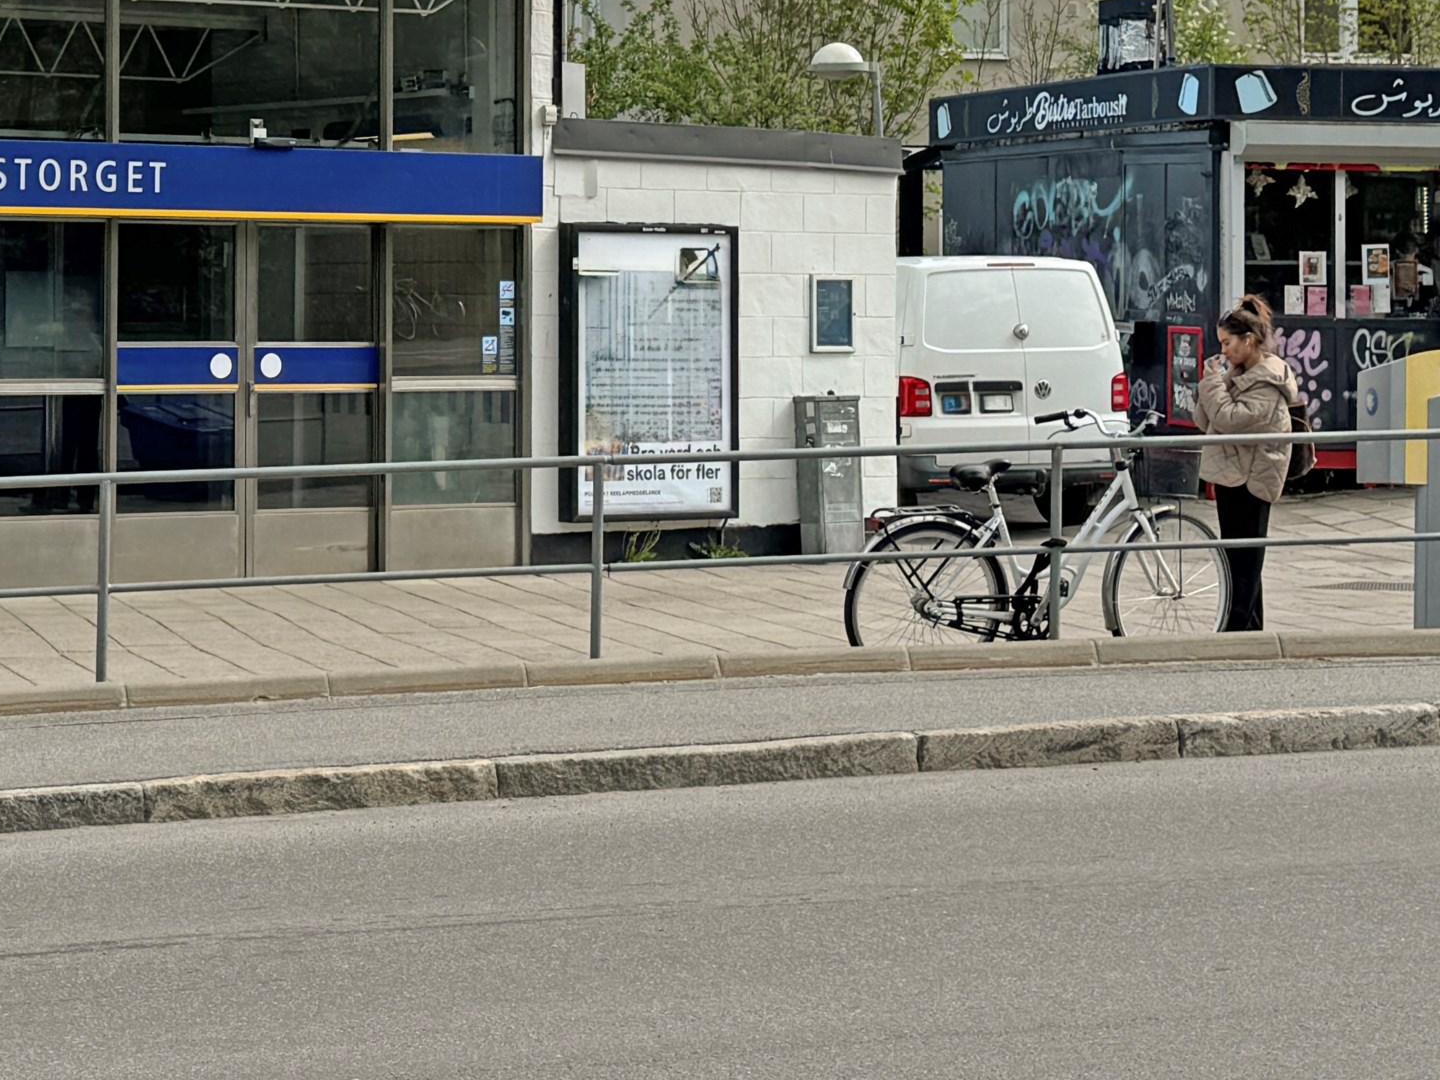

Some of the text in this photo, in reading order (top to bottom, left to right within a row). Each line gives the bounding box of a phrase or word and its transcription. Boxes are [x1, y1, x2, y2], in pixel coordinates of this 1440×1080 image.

[1033, 91, 1128, 130] Bistro Tarboush
[627, 464, 721, 481] skola för fler
